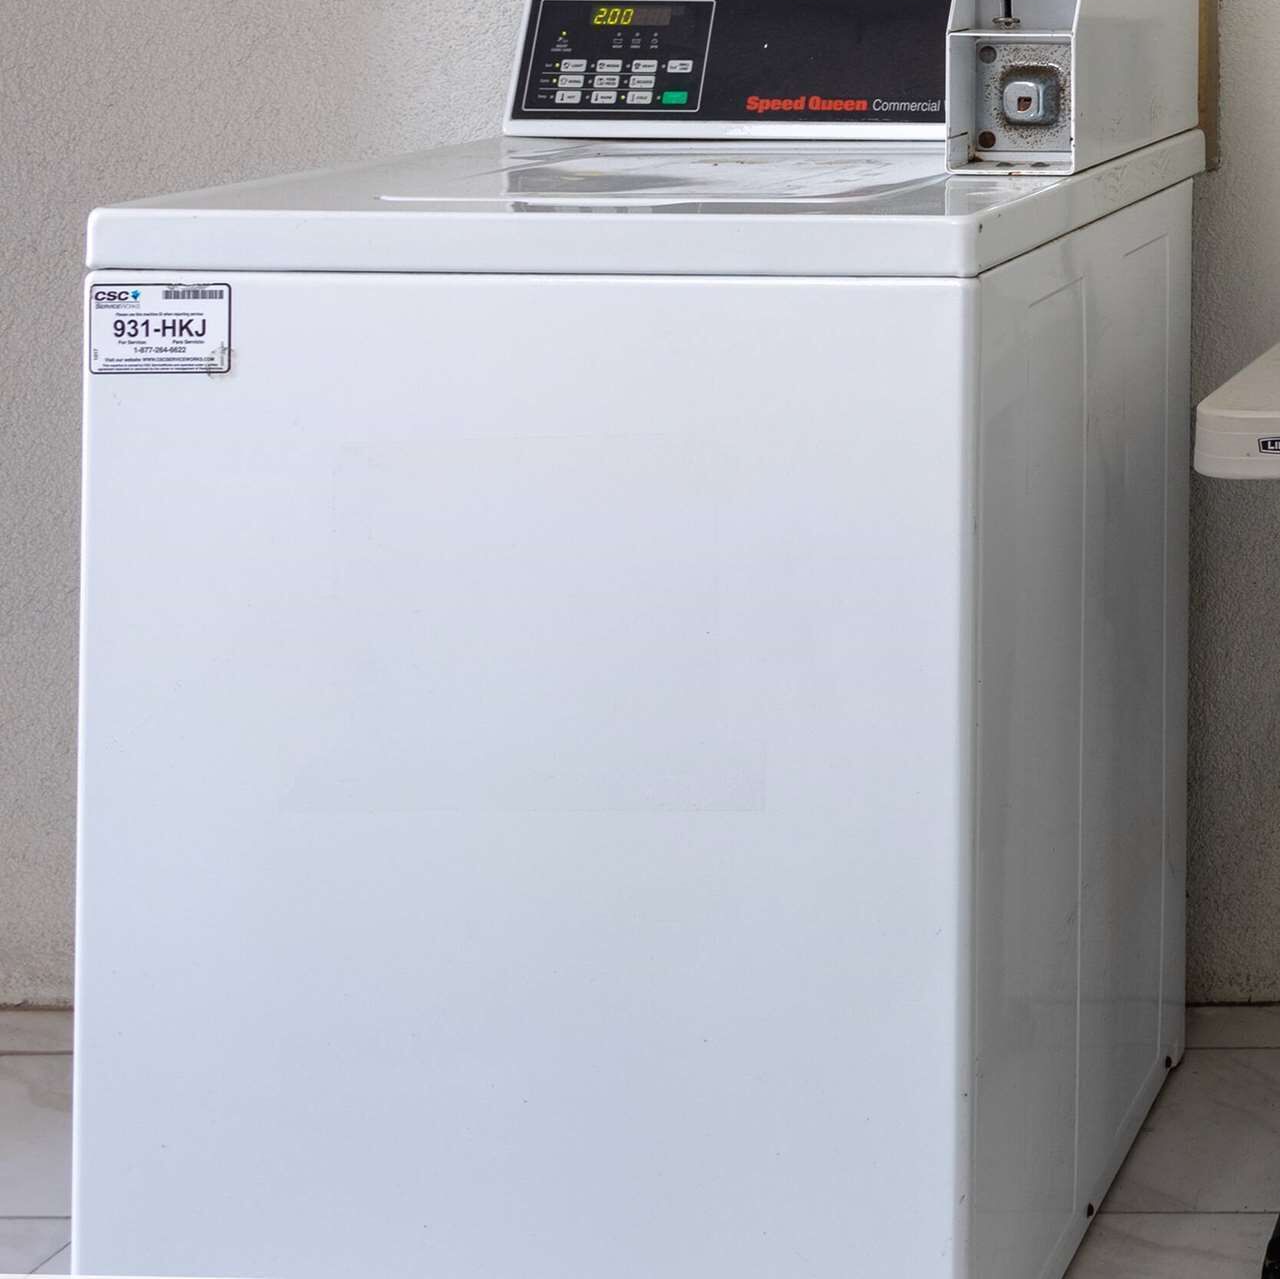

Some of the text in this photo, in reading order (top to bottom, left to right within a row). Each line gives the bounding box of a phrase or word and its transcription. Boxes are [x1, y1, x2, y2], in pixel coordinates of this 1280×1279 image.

[593, 7, 634, 25] 2.00
[746, 95, 941, 113] Speed Queen Commercial
[95, 291, 129, 301] CSC
[113, 319, 206, 337] 931-HKJ
